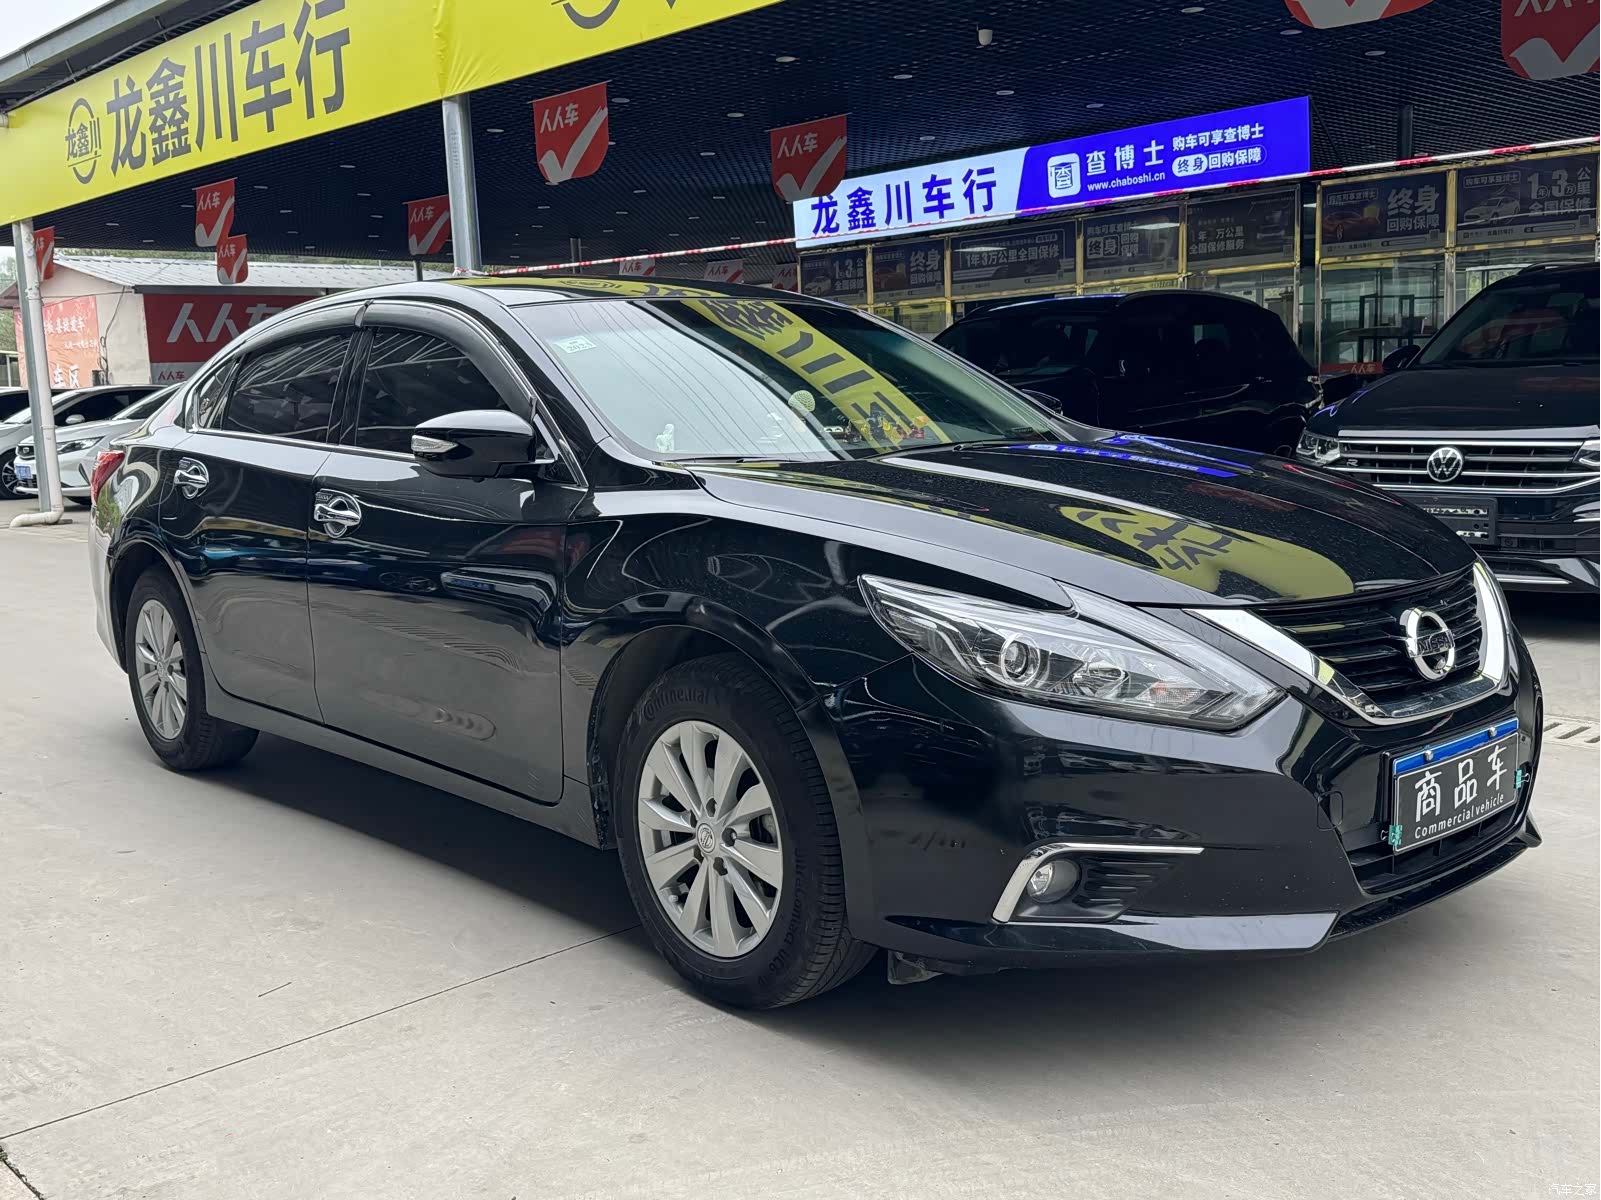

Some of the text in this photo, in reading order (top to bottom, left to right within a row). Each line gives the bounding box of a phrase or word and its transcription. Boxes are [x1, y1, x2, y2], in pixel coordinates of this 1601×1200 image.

[106, 0, 351, 176] 龙鑫川车行
[540, 102, 579, 134] 人人车
[65, 117, 102, 160] 龙鑫川
[776, 132, 818, 158] 人人车
[1172, 123, 1264, 152] 购车可享查博士
[1086, 140, 1164, 176] 查博士
[1087, 171, 1166, 192] www.chaboshi.cn
[198, 191, 221, 211] 人人车
[811, 166, 997, 235] 龙鑫川车行
[1386, 185, 1439, 216] 终身
[1528, 198, 1591, 217] 全国保修
[410, 206, 435, 224] 人人车
[1386, 214, 1440, 233] 回购保障
[218, 243, 236, 259] 人人车
[966, 244, 1060, 268] 1年3万公里全国保修
[1088, 237, 1118, 256] 终身
[622, 261, 641, 272] 人人车
[707, 265, 729, 276] 人人车
[910, 249, 941, 272] 终身
[158, 371, 185, 381] 人人车
[1414, 745, 1507, 823] 商品车
[1414, 793, 1504, 839] Commercial vehicle
